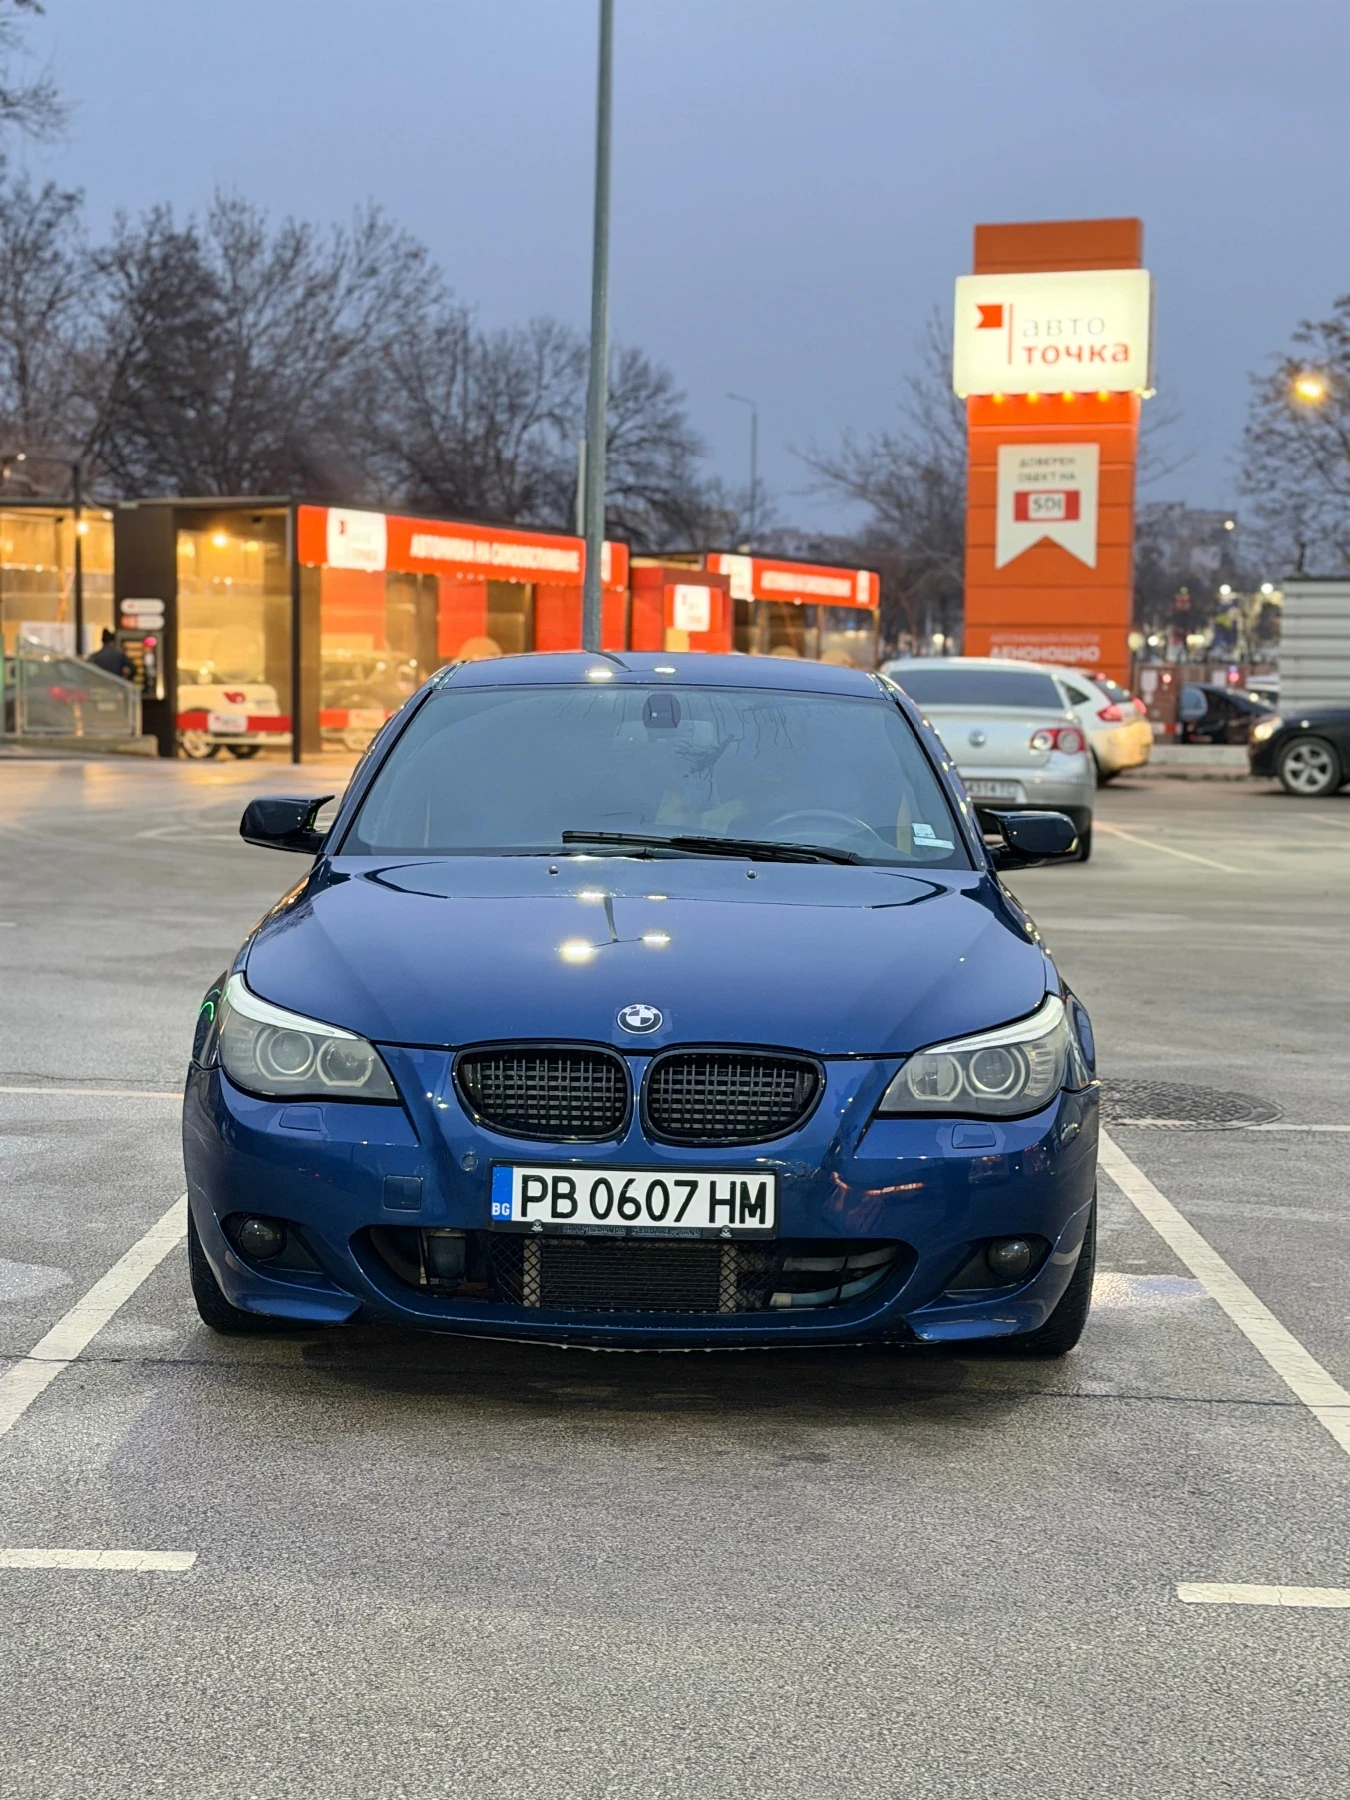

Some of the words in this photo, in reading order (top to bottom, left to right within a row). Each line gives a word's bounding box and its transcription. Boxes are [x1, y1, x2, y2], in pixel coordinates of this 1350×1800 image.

[1022, 316, 1106, 338] авто
[1021, 342, 1130, 366] точка
[1032, 496, 1062, 513] SDI
[492, 1202, 511, 1216] BG
[520, 1174, 578, 1219] PB
[589, 1177, 699, 1223] 0607
[708, 1179, 766, 1224] HM
